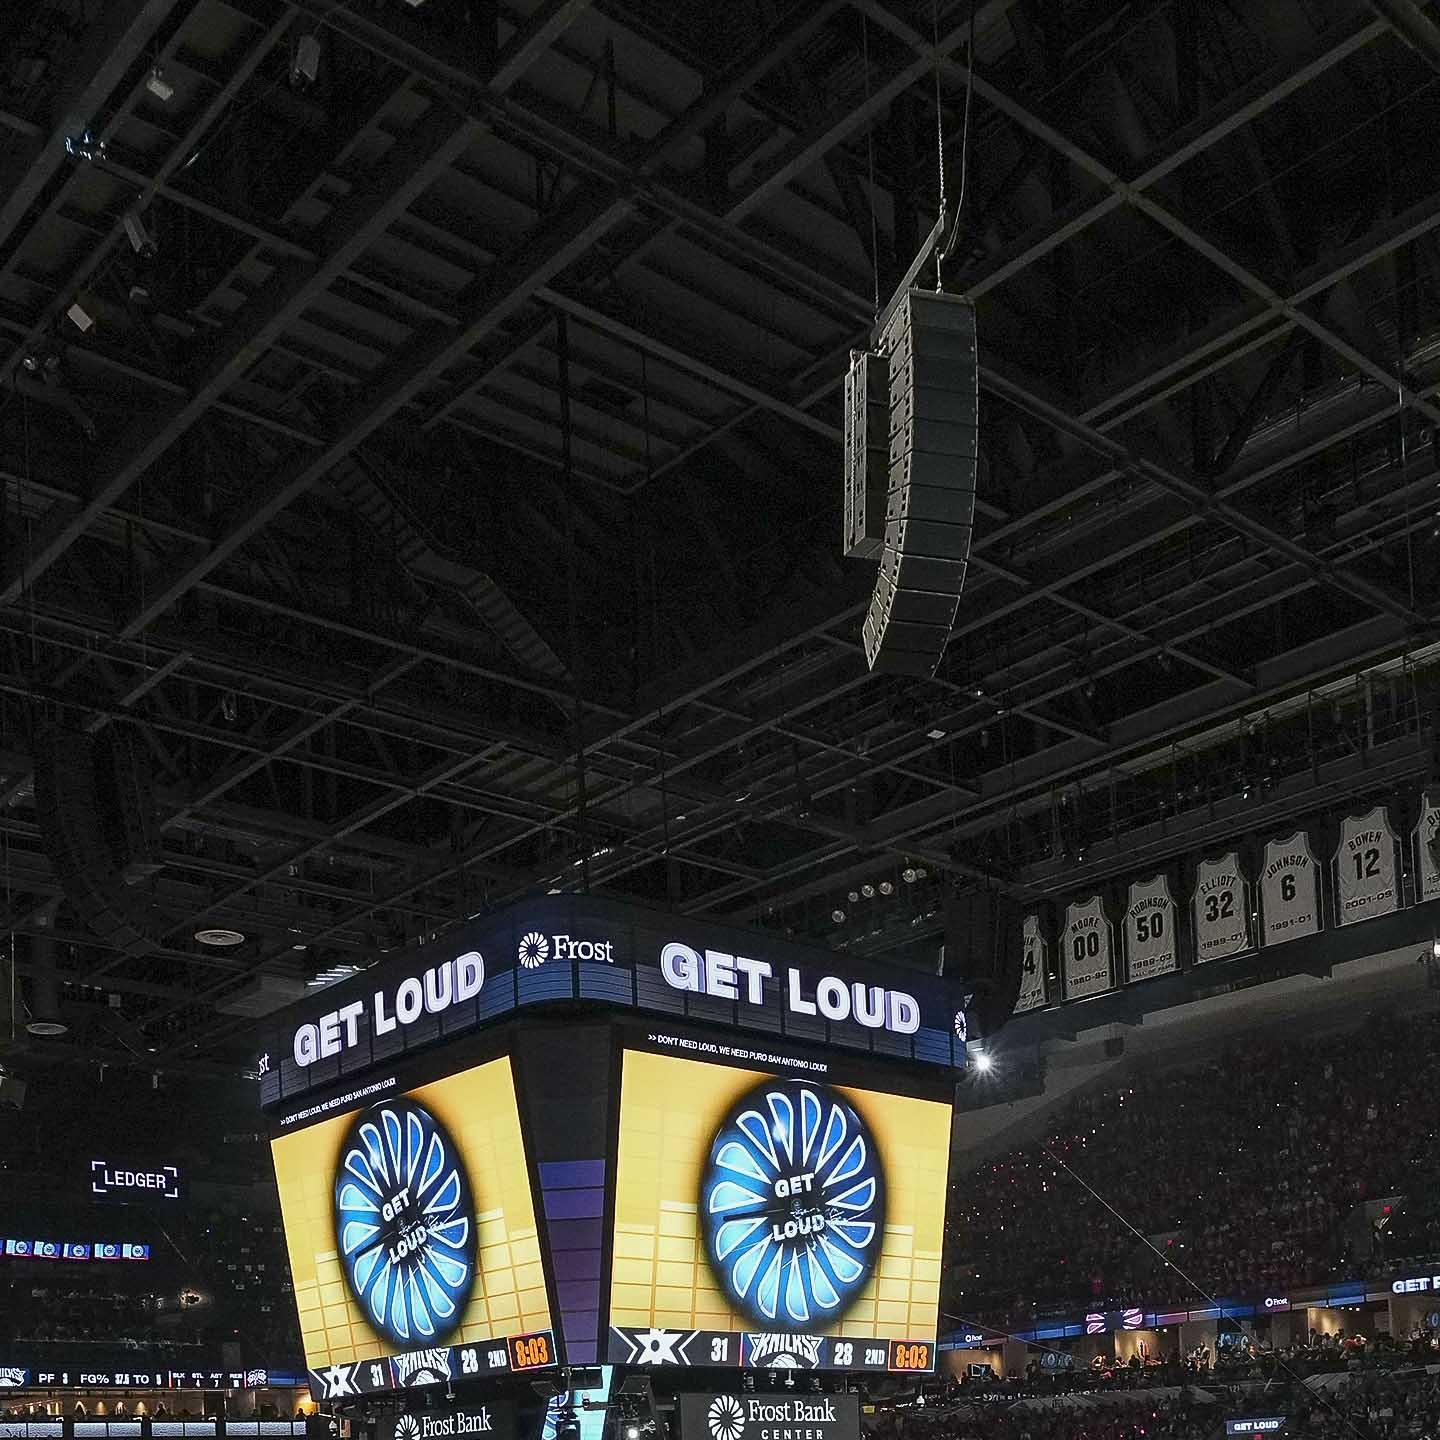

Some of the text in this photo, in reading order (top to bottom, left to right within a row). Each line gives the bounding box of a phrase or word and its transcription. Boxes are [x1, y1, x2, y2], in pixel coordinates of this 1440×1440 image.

[1348, 831, 1383, 851] BOWEN
[1266, 855, 1310, 879] JOHNSON
[1352, 847, 1380, 880] 12
[1200, 876, 1235, 894] ELLIOTT
[1280, 874, 1297, 902] 6
[1129, 897, 1169, 919] ROBINSON
[1205, 890, 1234, 922] 32
[1070, 917, 1100, 933] MOORE
[1135, 912, 1164, 943] 50
[1270, 913, 1312, 931] 1991-01
[552, 935, 614, 963] Frost
[1072, 931, 1100, 961] 00
[660, 942, 921, 1035] GET LOUD
[293, 951, 485, 1067] GET LOUD
[679, 1038, 698, 1050] NEED
[719, 1045, 730, 1056] WE
[730, 1047, 749, 1059] NEED
[749, 1051, 768, 1062] PURO
[768, 1054, 782, 1065] SAN
[781, 1057, 809, 1069] ANTONIO
[104, 1169, 166, 1189] LEDGER
[774, 1172, 815, 1198] GET
[382, 1187, 410, 1222] GET
[773, 1214, 825, 1242] LOUD
[389, 1225, 428, 1265] LOUD
[1392, 1277, 1431, 1294] GET
[370, 1336, 548, 1387] 31 28 2ND 8:03
[710, 1337, 729, 1362] 31
[834, 1342, 853, 1366] 28
[864, 1349, 885, 1365] 2ND
[895, 1344, 928, 1369] 8:03
[38, 1373, 56, 1383] PF
[80, 1374, 110, 1384] FG%
[132, 1374, 150, 1384] TO
[422, 1406, 493, 1438] Frost Bank
[748, 1398, 836, 1423] Frost Bank
[761, 1429, 824, 1440] CENTER
[1253, 1421, 1279, 1430] LOUD
